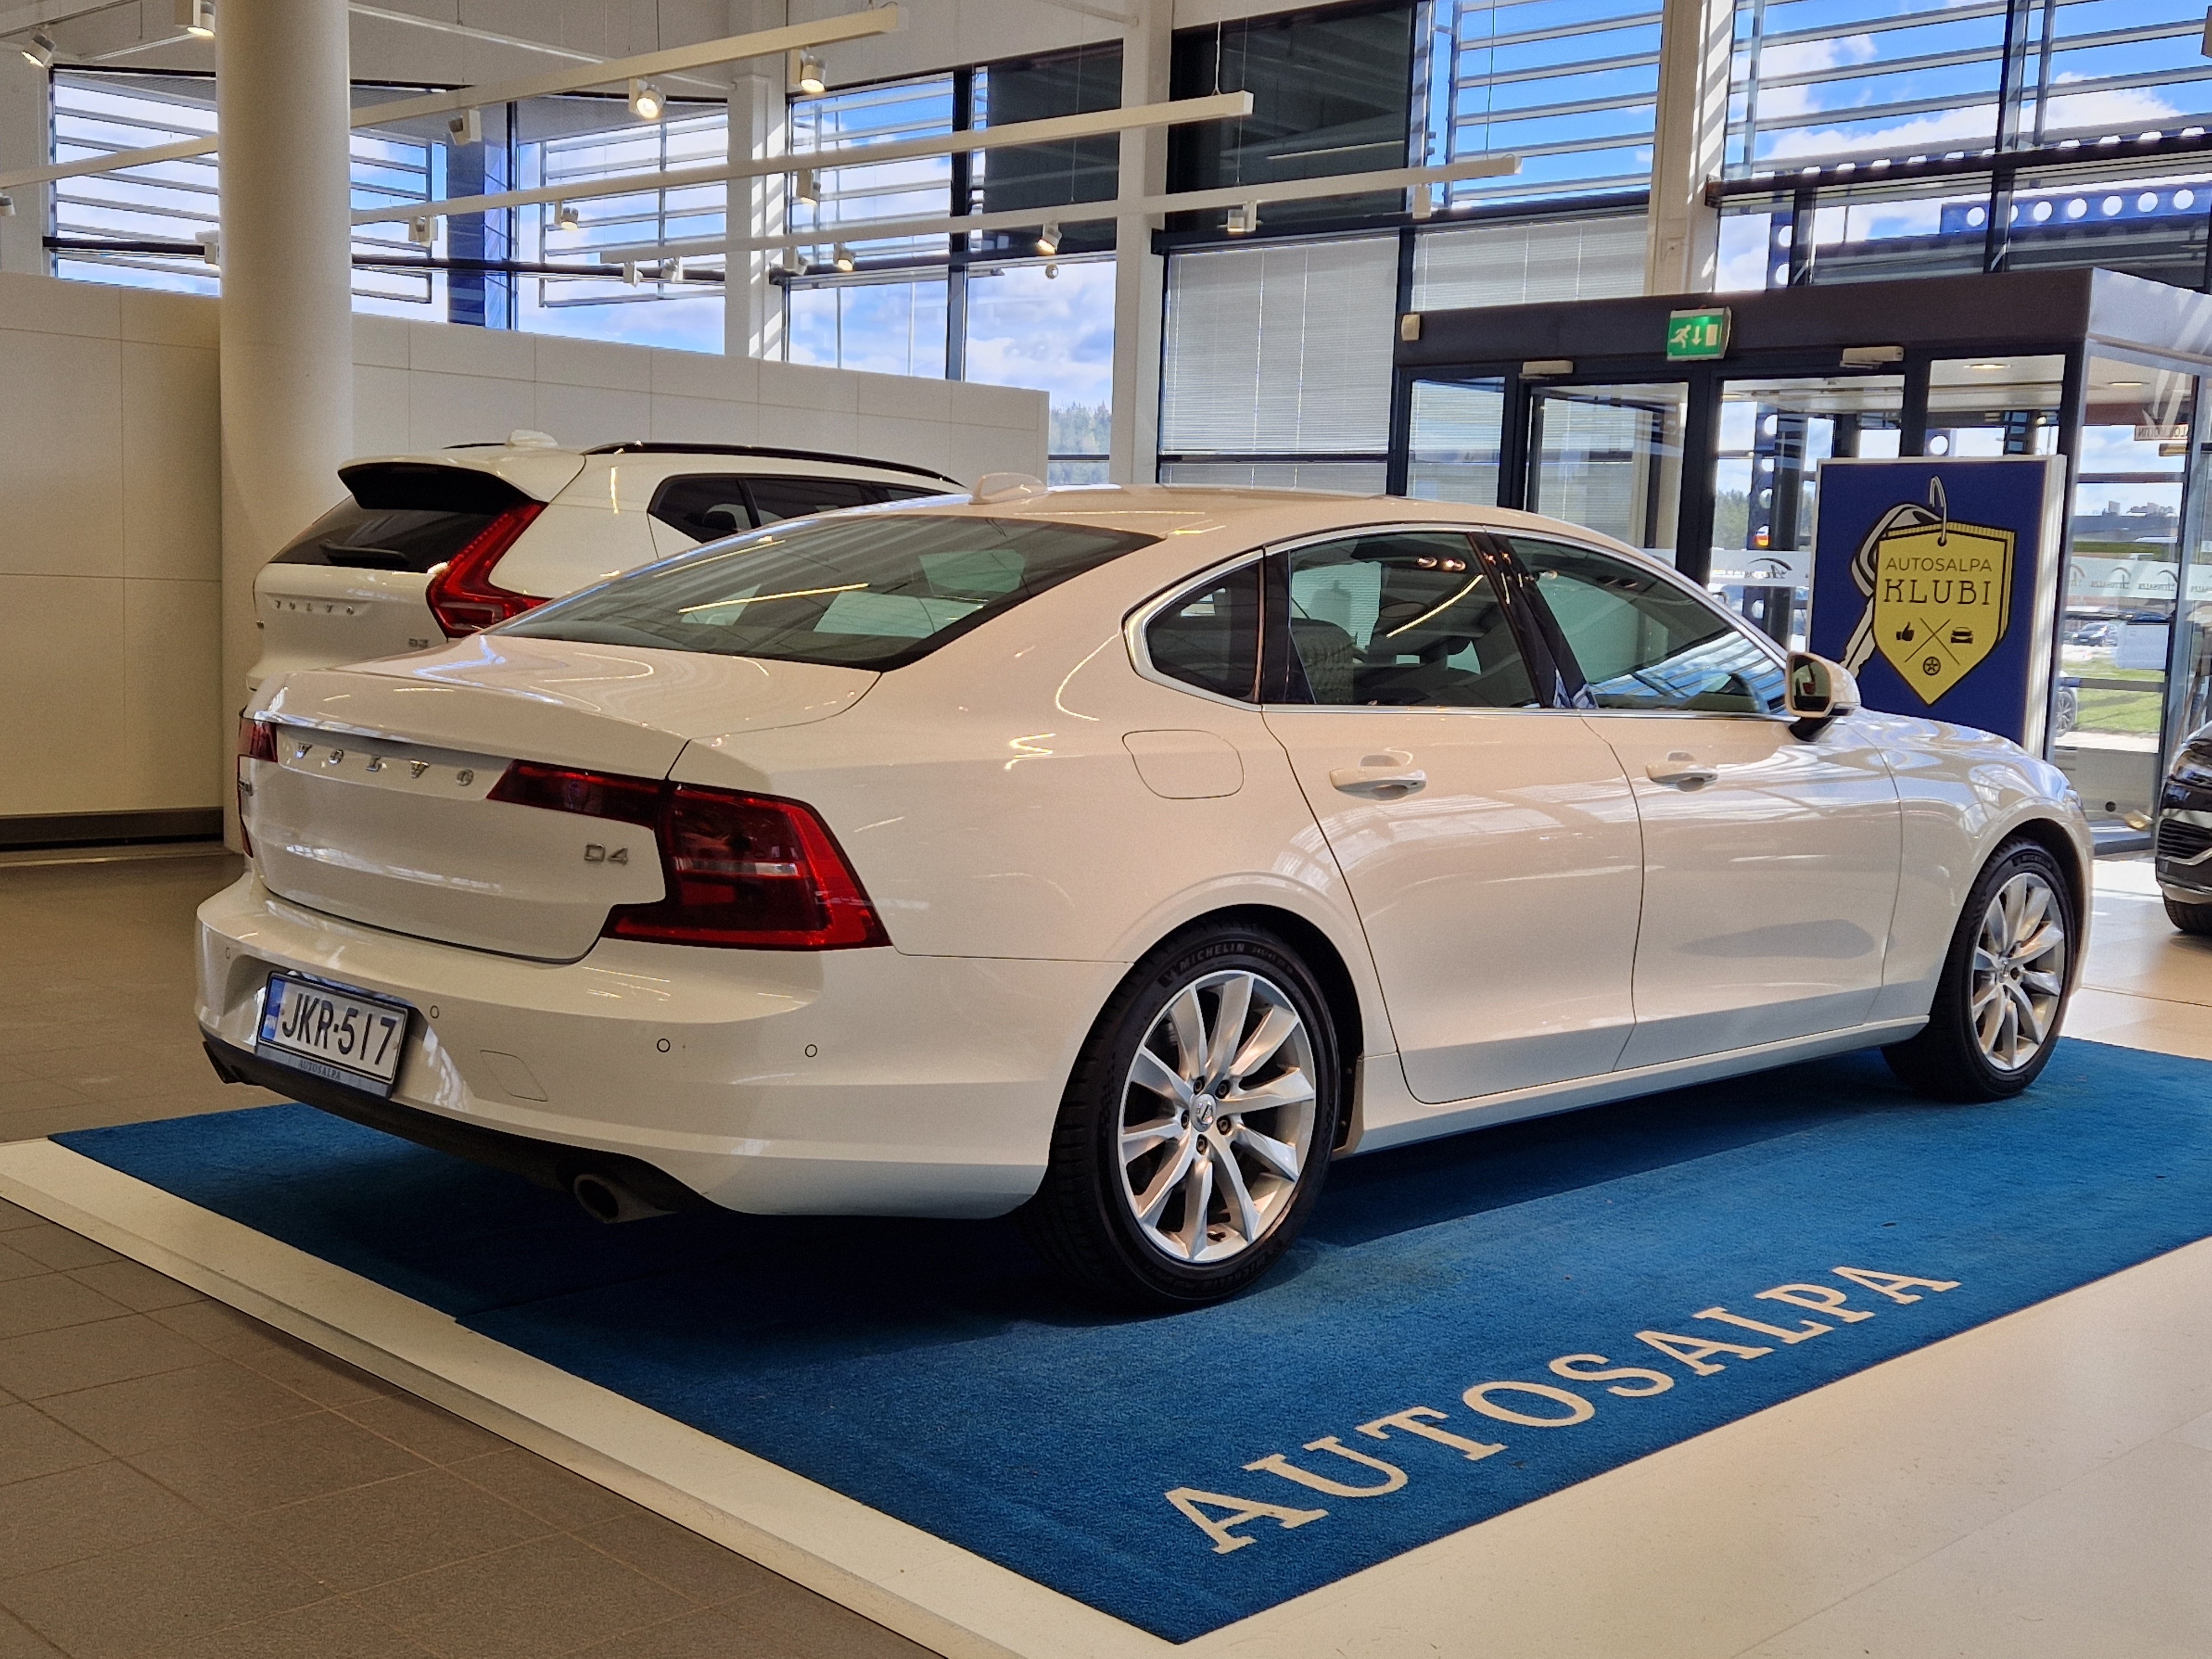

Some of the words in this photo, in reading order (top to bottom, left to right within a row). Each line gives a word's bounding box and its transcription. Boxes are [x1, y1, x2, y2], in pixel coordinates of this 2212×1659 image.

[1885, 557, 1992, 572] AUTOSALPA
[1884, 578, 1991, 606] KLUBI
[275, 599, 354, 615] VOLVO
[295, 742, 474, 786] VOLVO
[585, 844, 629, 866] D4
[1180, 942, 1244, 973] MICHELIN
[282, 993, 397, 1065] JKR-517
[299, 1060, 341, 1081] AUTOSALPA
[1164, 1265, 1963, 1555] AUTOSALPA
